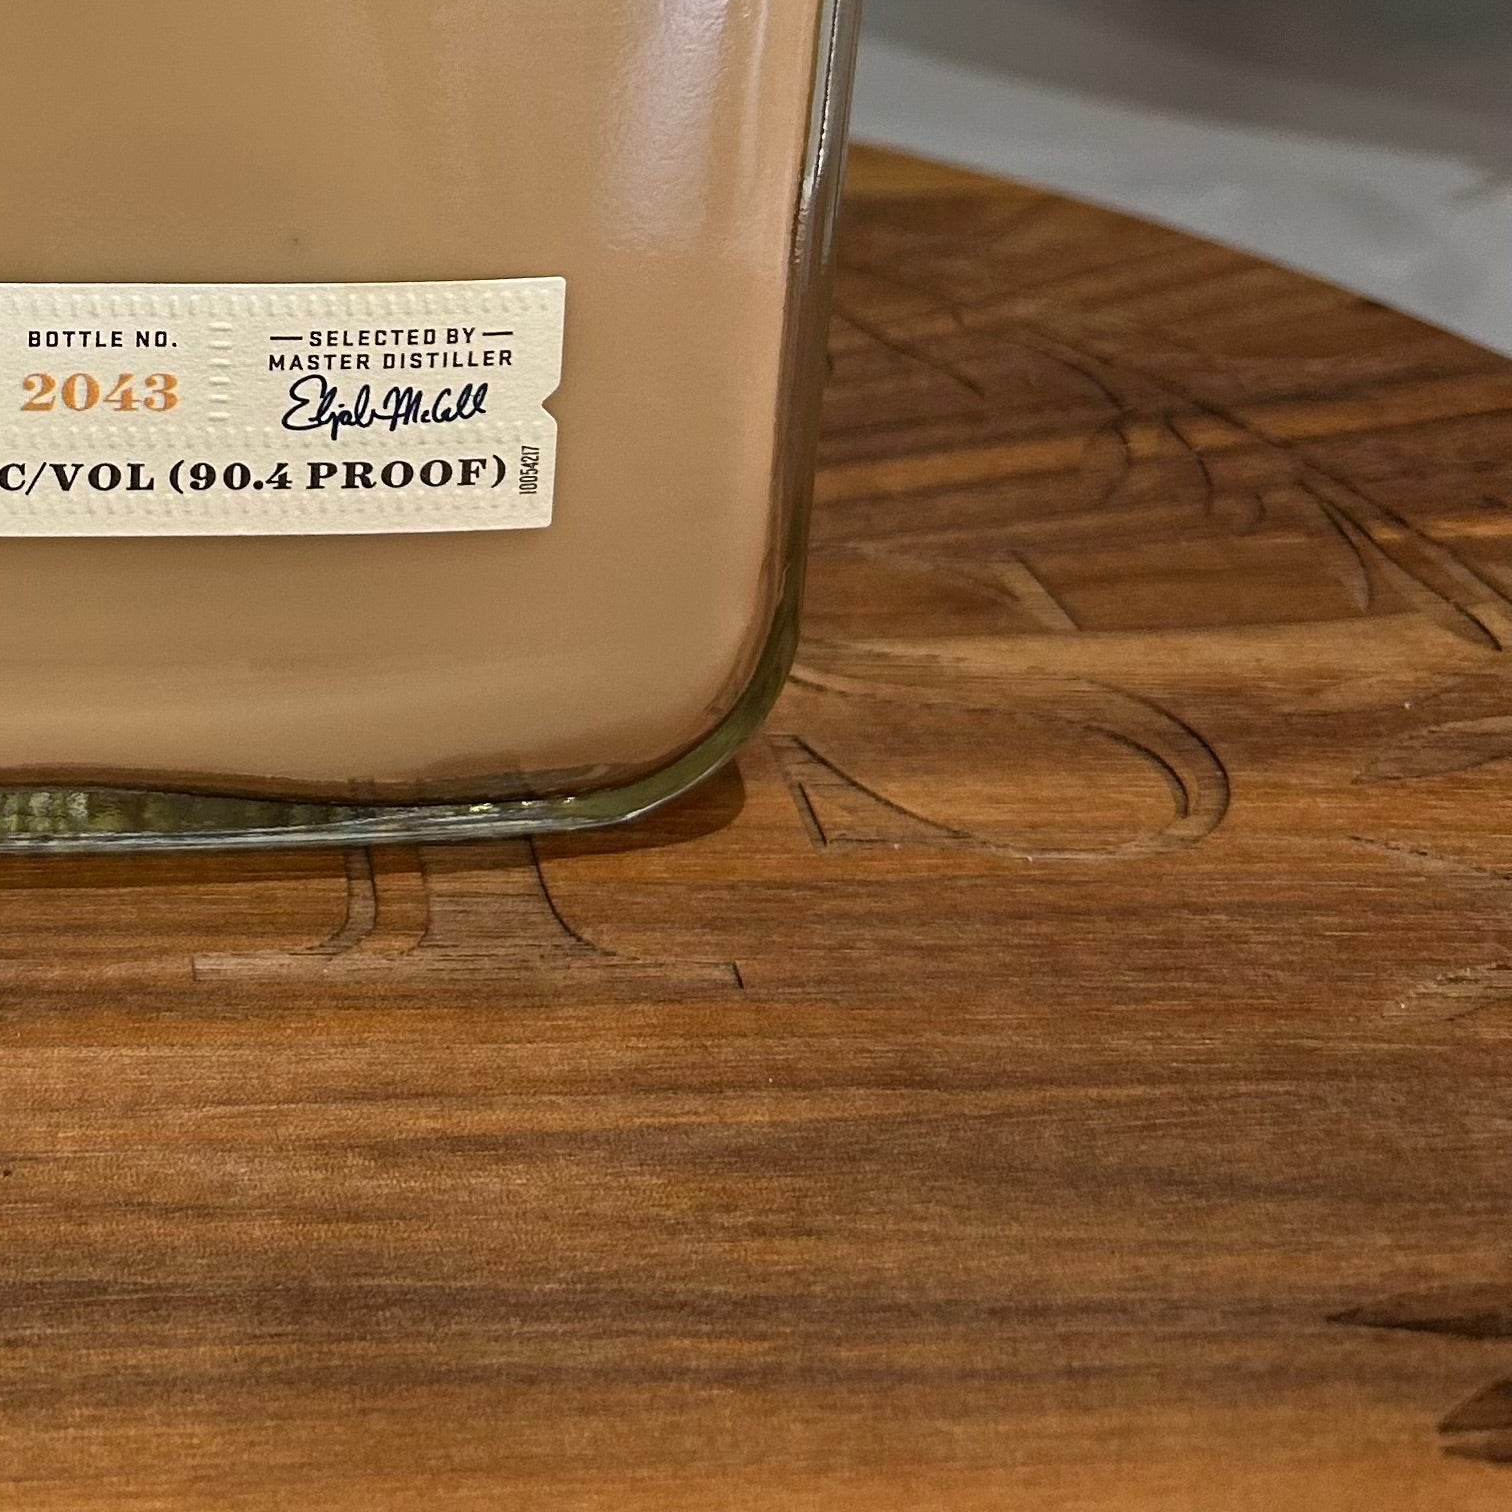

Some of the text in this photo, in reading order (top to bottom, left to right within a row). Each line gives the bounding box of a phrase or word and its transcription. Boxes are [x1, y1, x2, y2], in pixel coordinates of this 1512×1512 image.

[28, 330, 177, 348] BOTTLE NO.
[309, 327, 476, 347] SELECTED BY
[268, 349, 512, 372] MASTER DISTILLER
[22, 373, 179, 412] 2043
[169, 459, 293, 495] (90.4
[305, 454, 506, 490] PROOF)
[518, 445, 540, 495] 10054217
